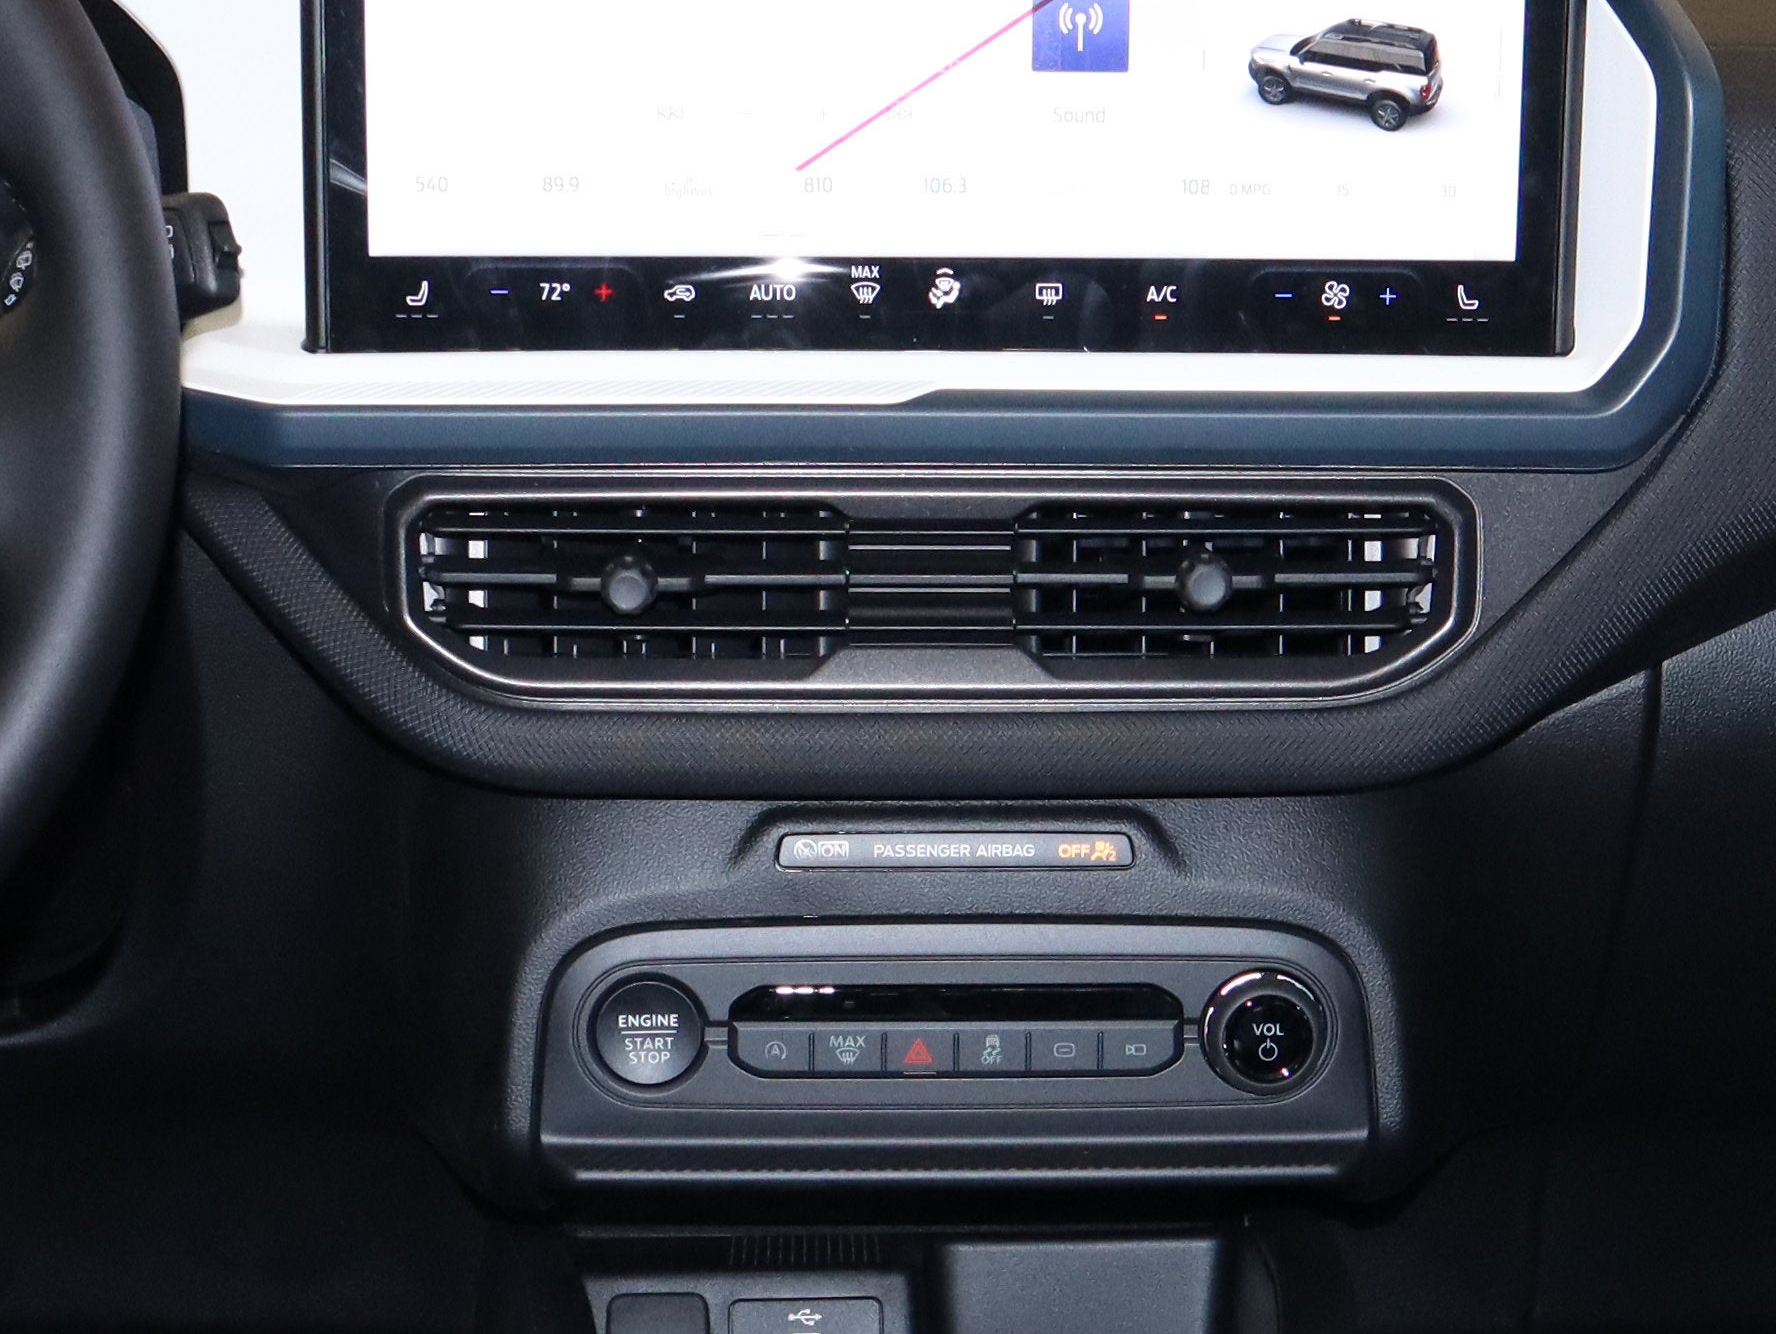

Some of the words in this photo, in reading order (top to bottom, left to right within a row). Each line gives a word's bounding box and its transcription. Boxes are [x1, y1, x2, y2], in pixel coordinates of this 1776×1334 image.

[1052, 105, 1107, 125] Sound
[415, 175, 449, 194] 540
[541, 174, 580, 194] 89.9
[803, 175, 833, 194] 810
[922, 175, 968, 195] 106.3
[1180, 178, 1211, 196] 108
[850, 265, 881, 280] MAX
[749, 282, 797, 302] AUTO
[1147, 282, 1178, 304] A/C
[822, 843, 846, 857] ON
[873, 843, 971, 858] PASSENGER
[975, 843, 1036, 857] AIRBAG
[1057, 843, 1091, 858] OFF
[618, 1014, 679, 1027] ENGINE
[1252, 1023, 1284, 1036] VOL
[624, 1037, 674, 1050] START
[829, 1035, 866, 1048] MAX
[629, 1051, 671, 1064] STOP
[981, 1055, 1003, 1065] OFF
